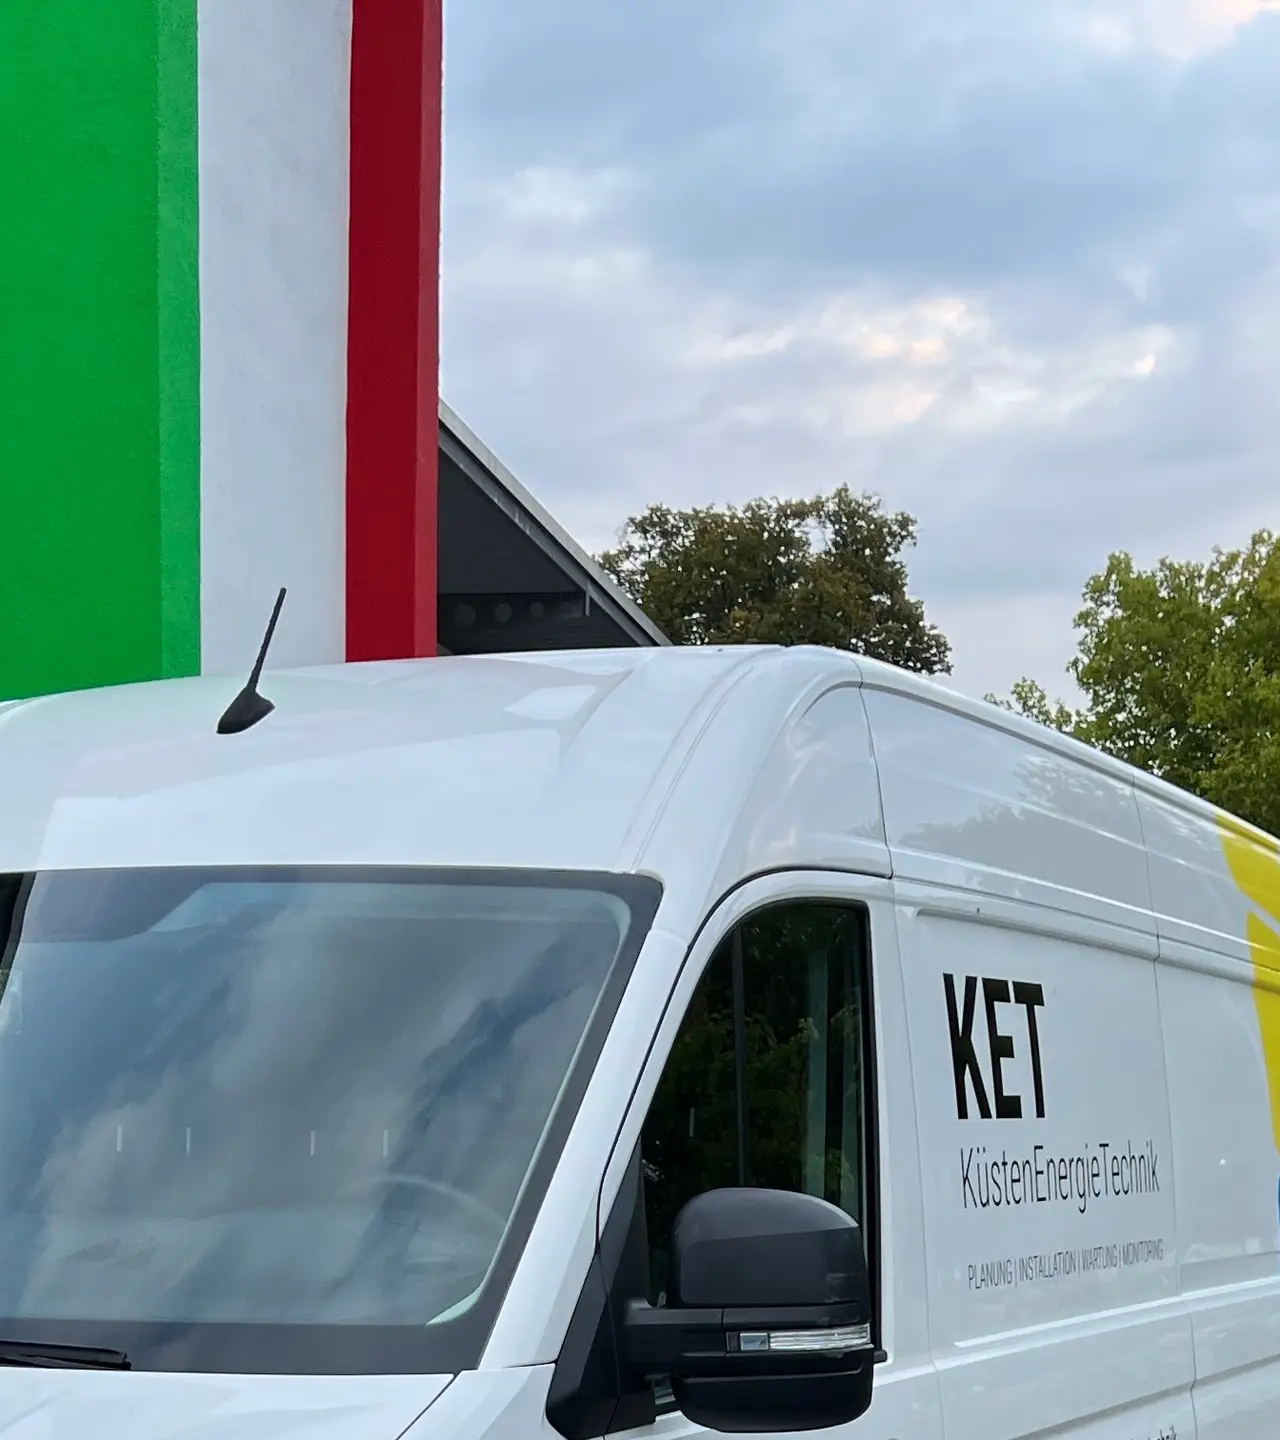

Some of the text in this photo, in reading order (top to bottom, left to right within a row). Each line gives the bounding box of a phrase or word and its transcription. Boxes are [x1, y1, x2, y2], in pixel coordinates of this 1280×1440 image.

[943, 972, 1045, 1119] KET
[960, 1139, 1160, 1213] KüstenEnergieTechnik
[968, 1259, 1013, 1290] PLANUNG
[1019, 1251, 1076, 1281] INSTALLATION
[1082, 1244, 1118, 1271] WARTUNG
[1122, 1238, 1164, 1265] MONITORING
